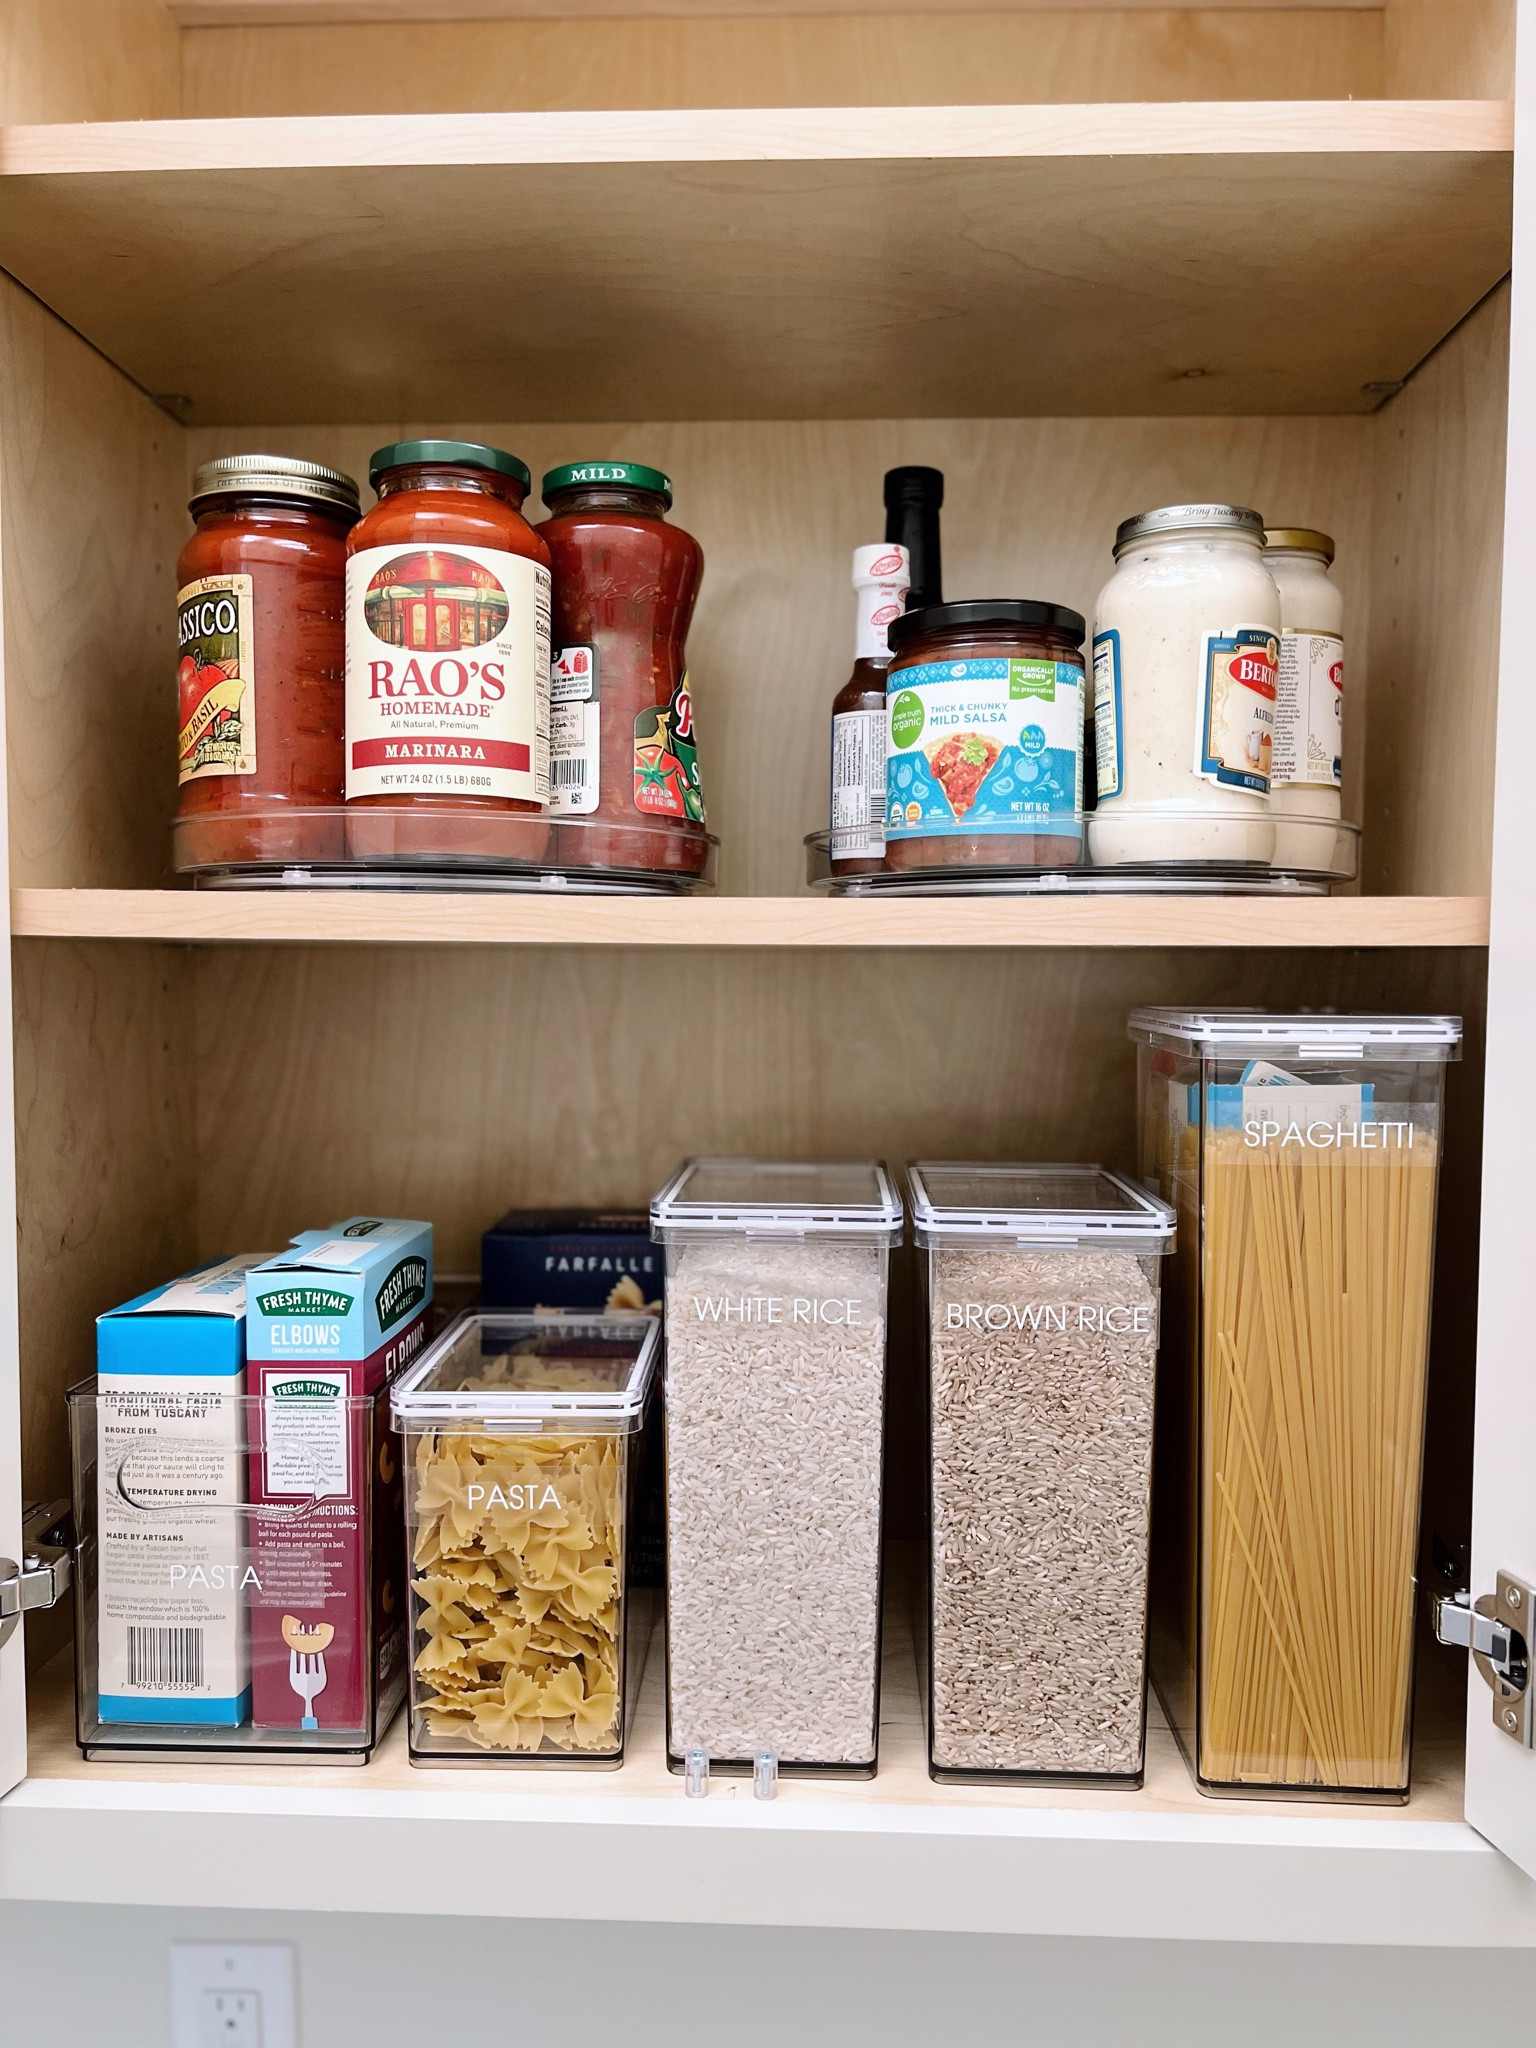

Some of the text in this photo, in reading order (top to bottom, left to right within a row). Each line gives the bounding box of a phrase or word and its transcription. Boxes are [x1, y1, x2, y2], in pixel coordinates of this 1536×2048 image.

[571, 468, 626, 481] MILD
[217, 479, 232, 487] THE
[282, 479, 295, 488] OF
[300, 482, 325, 495] ITALY
[1182, 507, 1210, 519] Bring
[1213, 507, 1243, 522] Tuscany
[375, 569, 397, 584] RAO'S
[496, 642, 512, 650] SINCE
[553, 652, 558, 660] 3
[1012, 666, 1054, 675] ORGANICALLY
[368, 658, 506, 701] RAO'S
[1021, 686, 1054, 694] preservatives
[380, 702, 491, 718] HOMEMADE
[907, 709, 921, 717] truth
[931, 704, 956, 713] THICK
[967, 702, 1008, 711] CHUNKY
[192, 698, 218, 734] BASIL
[930, 712, 1007, 726] MILD SALSA
[390, 720, 479, 730] All Natural, Premium
[892, 716, 921, 731] organic
[385, 744, 486, 760] MARINARA
[381, 774, 491, 786] NET WT 24 OZ (1.5 LB) 680G
[1011, 802, 1050, 812] NET WT 16 OZ
[1244, 1120, 1413, 1149] SPAGHETTI
[545, 1256, 654, 1272] FARFALLE
[379, 1263, 424, 1320] FRESH THYME
[262, 1291, 348, 1311] FRESH THYME
[395, 1292, 413, 1314] MARKET
[694, 1296, 862, 1325] WHITE RICE
[947, 1303, 1149, 1333] BROWN RICE
[271, 1324, 340, 1345] ELBOWS
[276, 1383, 336, 1396] FRESH THYME
[118, 1408, 207, 1418] FROM TUSCANY
[198, 1464, 215, 1472] cling
[182, 1472, 208, 1480] century
[128, 1488, 217, 1496] TEMPERATURE DRYING
[468, 1484, 562, 1510] PASTA
[338, 1522, 357, 1530] rolling
[292, 1531, 310, 1539] pound
[106, 1543, 129, 1551] Crafted
[170, 1545, 192, 1553] family
[333, 1541, 345, 1549] boil,
[127, 1553, 183, 1561] pasta production
[170, 1564, 262, 1591] PASTA
[107, 1603, 127, 1611] detach
[125, 1612, 165, 1621] compostable
[180, 1613, 227, 1622] biodegradable.
[137, 1682, 163, 1690] 99210
[167, 1683, 195, 1691] 55552
